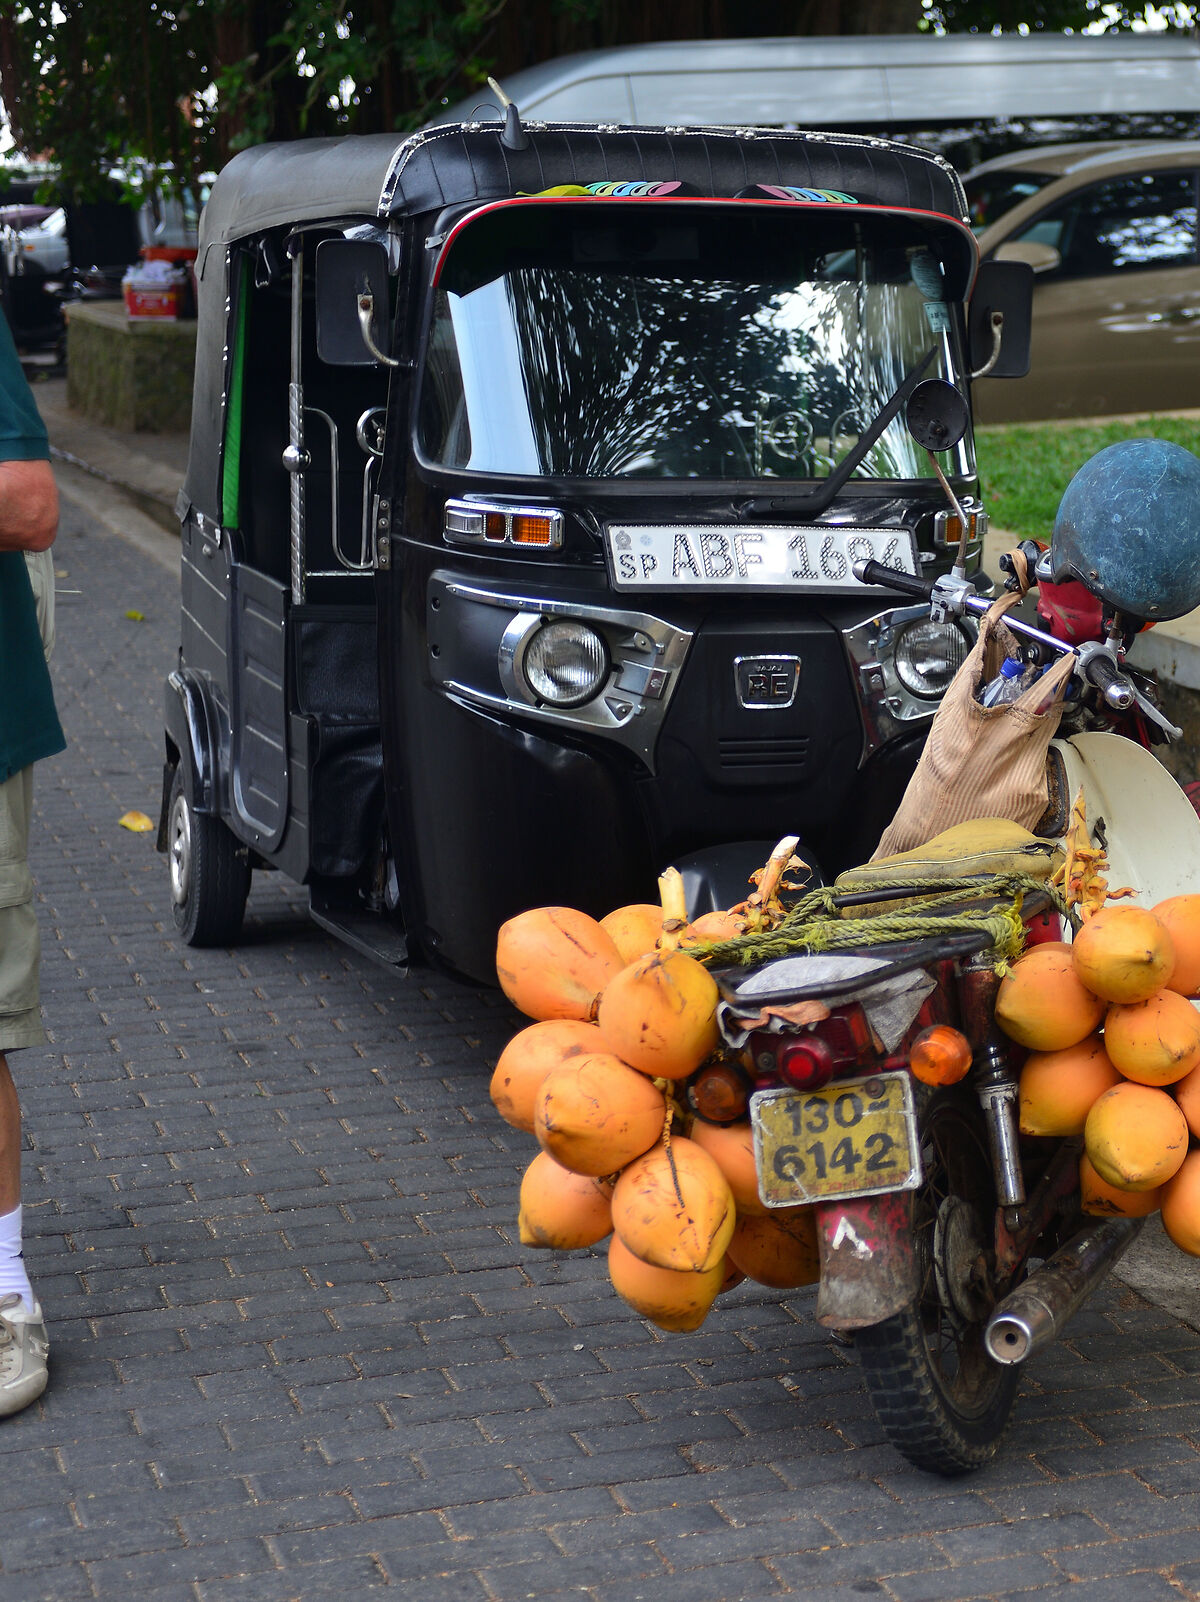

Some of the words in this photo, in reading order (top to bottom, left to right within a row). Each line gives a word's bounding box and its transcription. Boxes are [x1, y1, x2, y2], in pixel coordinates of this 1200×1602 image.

[618, 553, 658, 579] SP
[671, 532, 763, 579] ABF
[748, 673, 789, 697] RE
[772, 1132, 898, 1183] 6142
